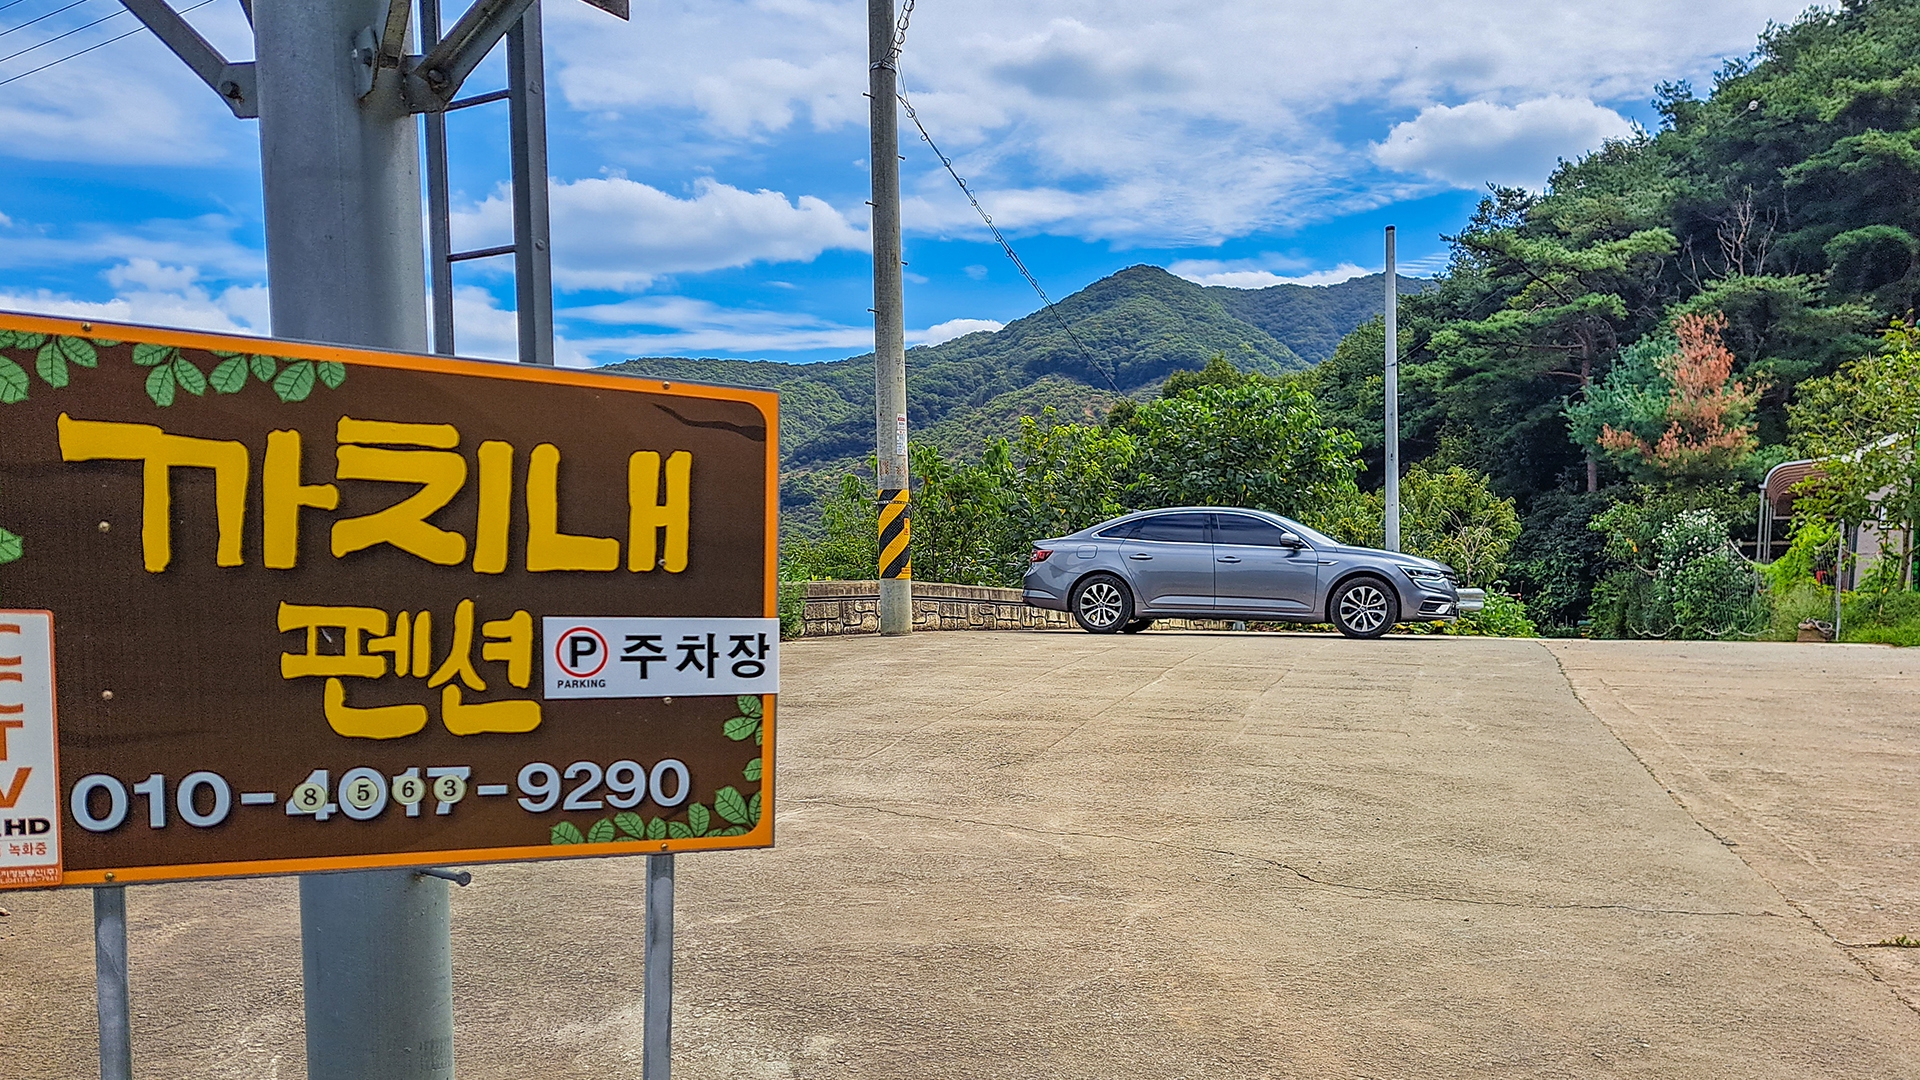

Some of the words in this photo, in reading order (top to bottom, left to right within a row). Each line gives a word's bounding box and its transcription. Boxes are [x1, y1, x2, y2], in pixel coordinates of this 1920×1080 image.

[57, 412, 693, 574] 까치내
[277, 599, 542, 740] 펜션
[569, 636, 597, 668] P
[620, 632, 770, 680] 주차장
[557, 679, 607, 689] PARKING
[9, 842, 47, 857] 녹화중
